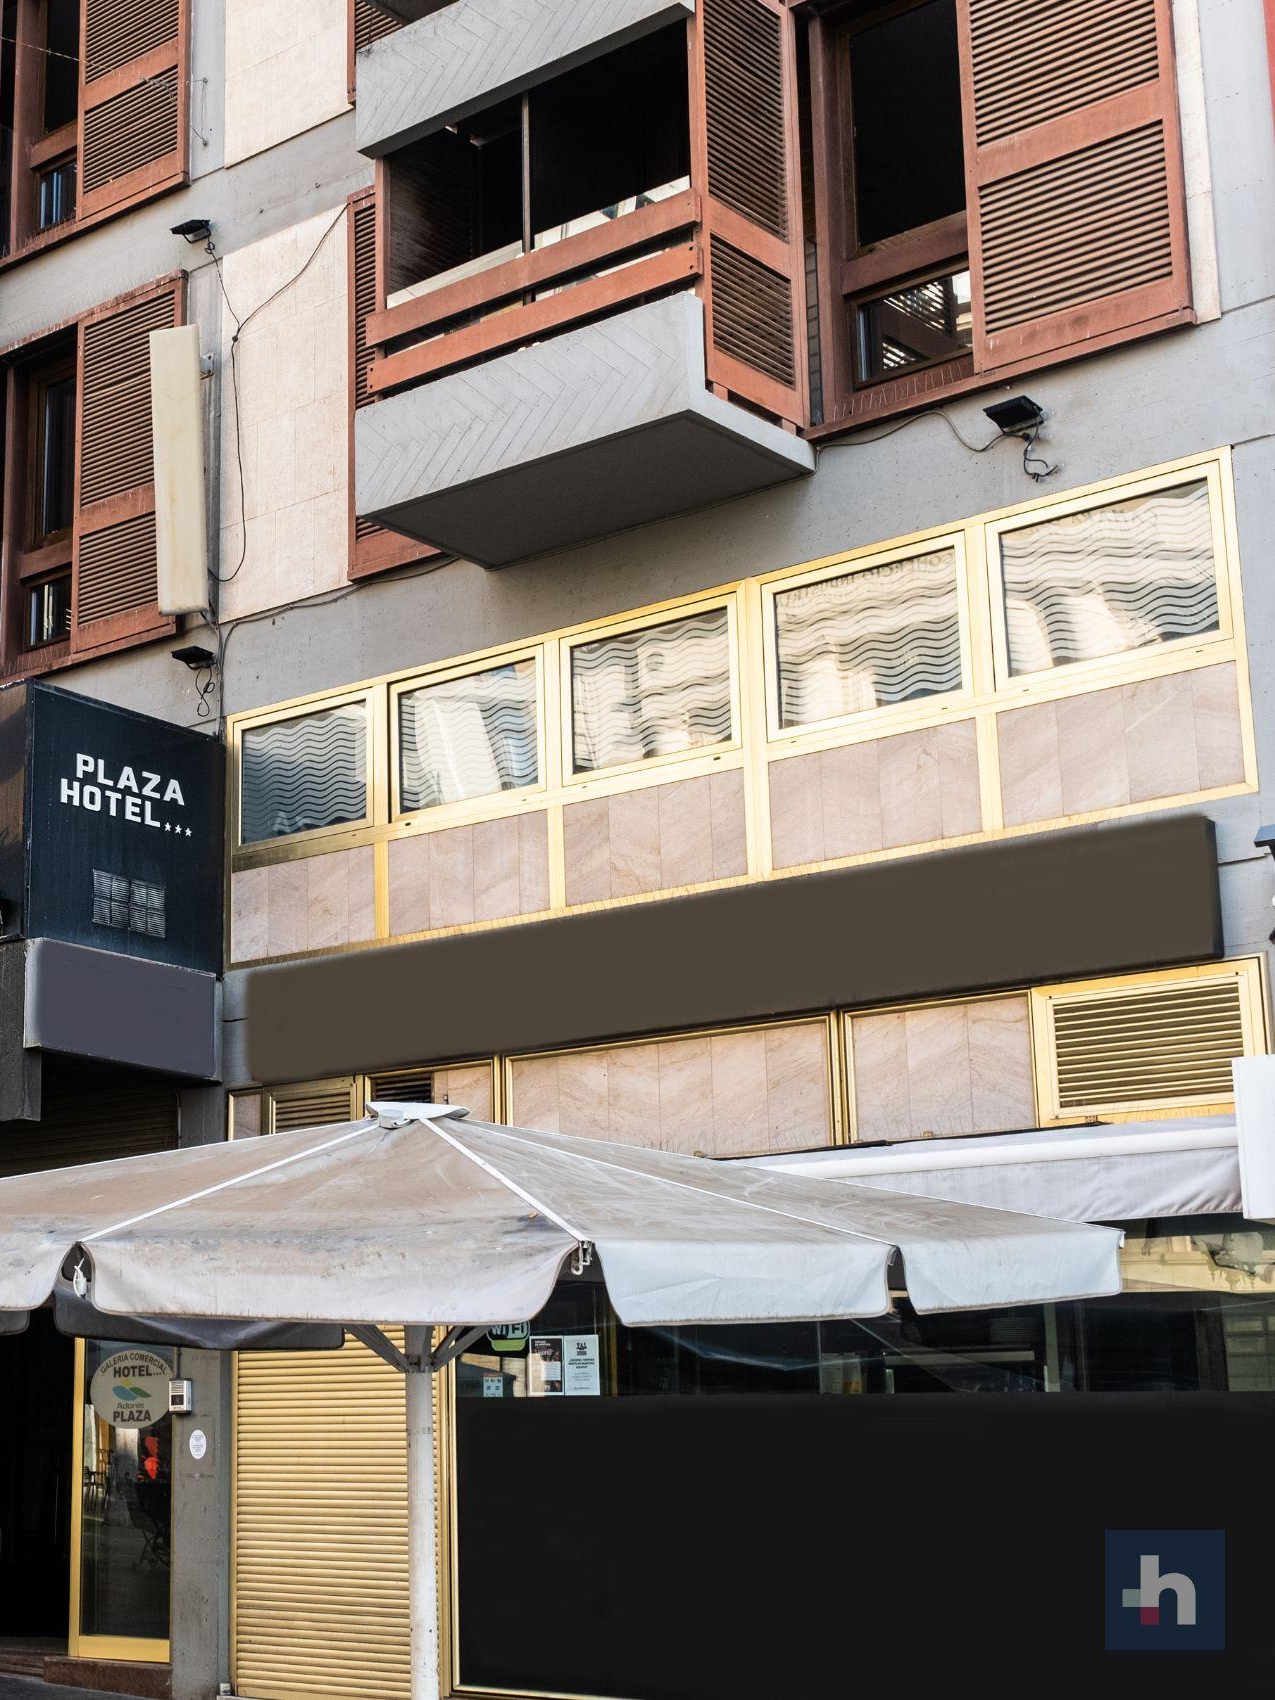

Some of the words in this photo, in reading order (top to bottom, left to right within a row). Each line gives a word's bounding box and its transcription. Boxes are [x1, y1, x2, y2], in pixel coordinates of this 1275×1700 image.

[76, 752, 185, 806] PLAZA
[60, 777, 161, 828] HOTEL
[113, 1365, 153, 1378] HOTEL
[129, 1352, 166, 1375] COMERCIAL
[116, 1401, 145, 1410] Adonis
[112, 1410, 152, 1422] PLAZA
